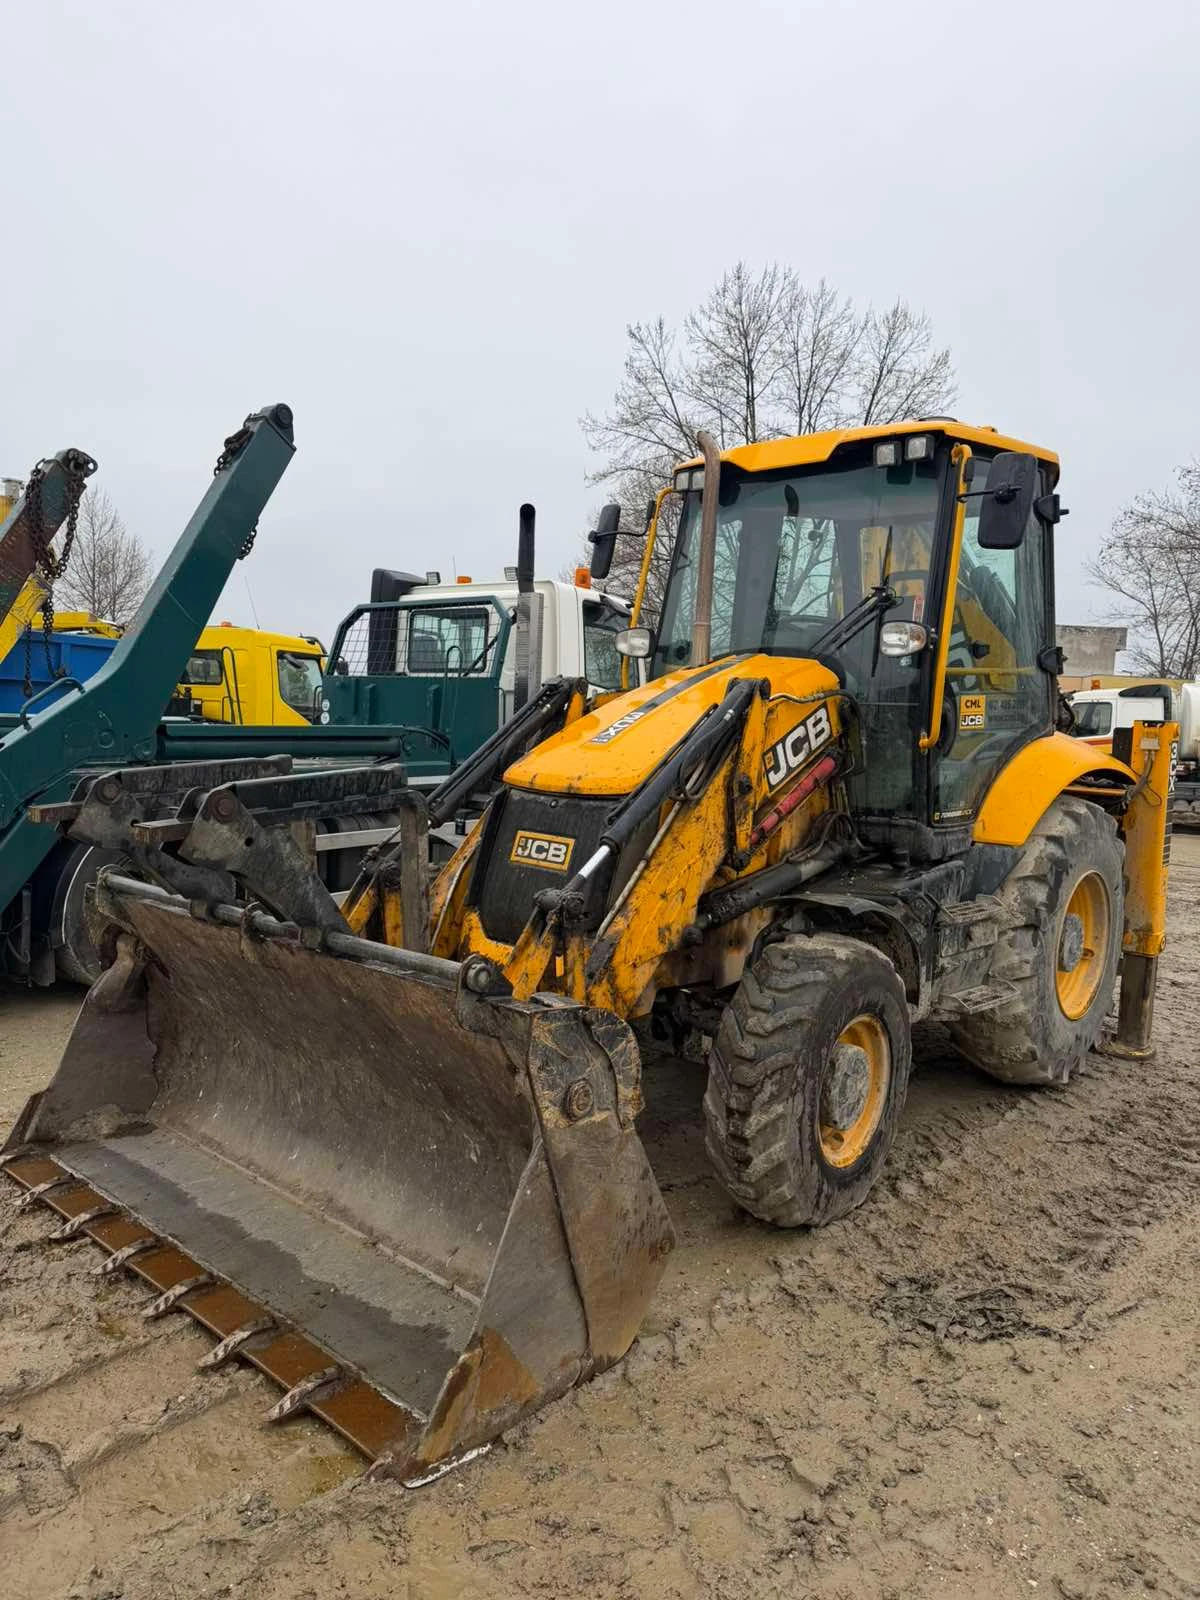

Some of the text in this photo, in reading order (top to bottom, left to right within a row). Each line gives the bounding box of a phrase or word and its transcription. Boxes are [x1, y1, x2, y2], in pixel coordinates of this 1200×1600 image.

[964, 699, 982, 709] CML
[961, 714, 984, 726] JCB
[767, 707, 831, 786] JCB
[1168, 741, 1178, 792] 3CX
[516, 838, 567, 863] JCB
